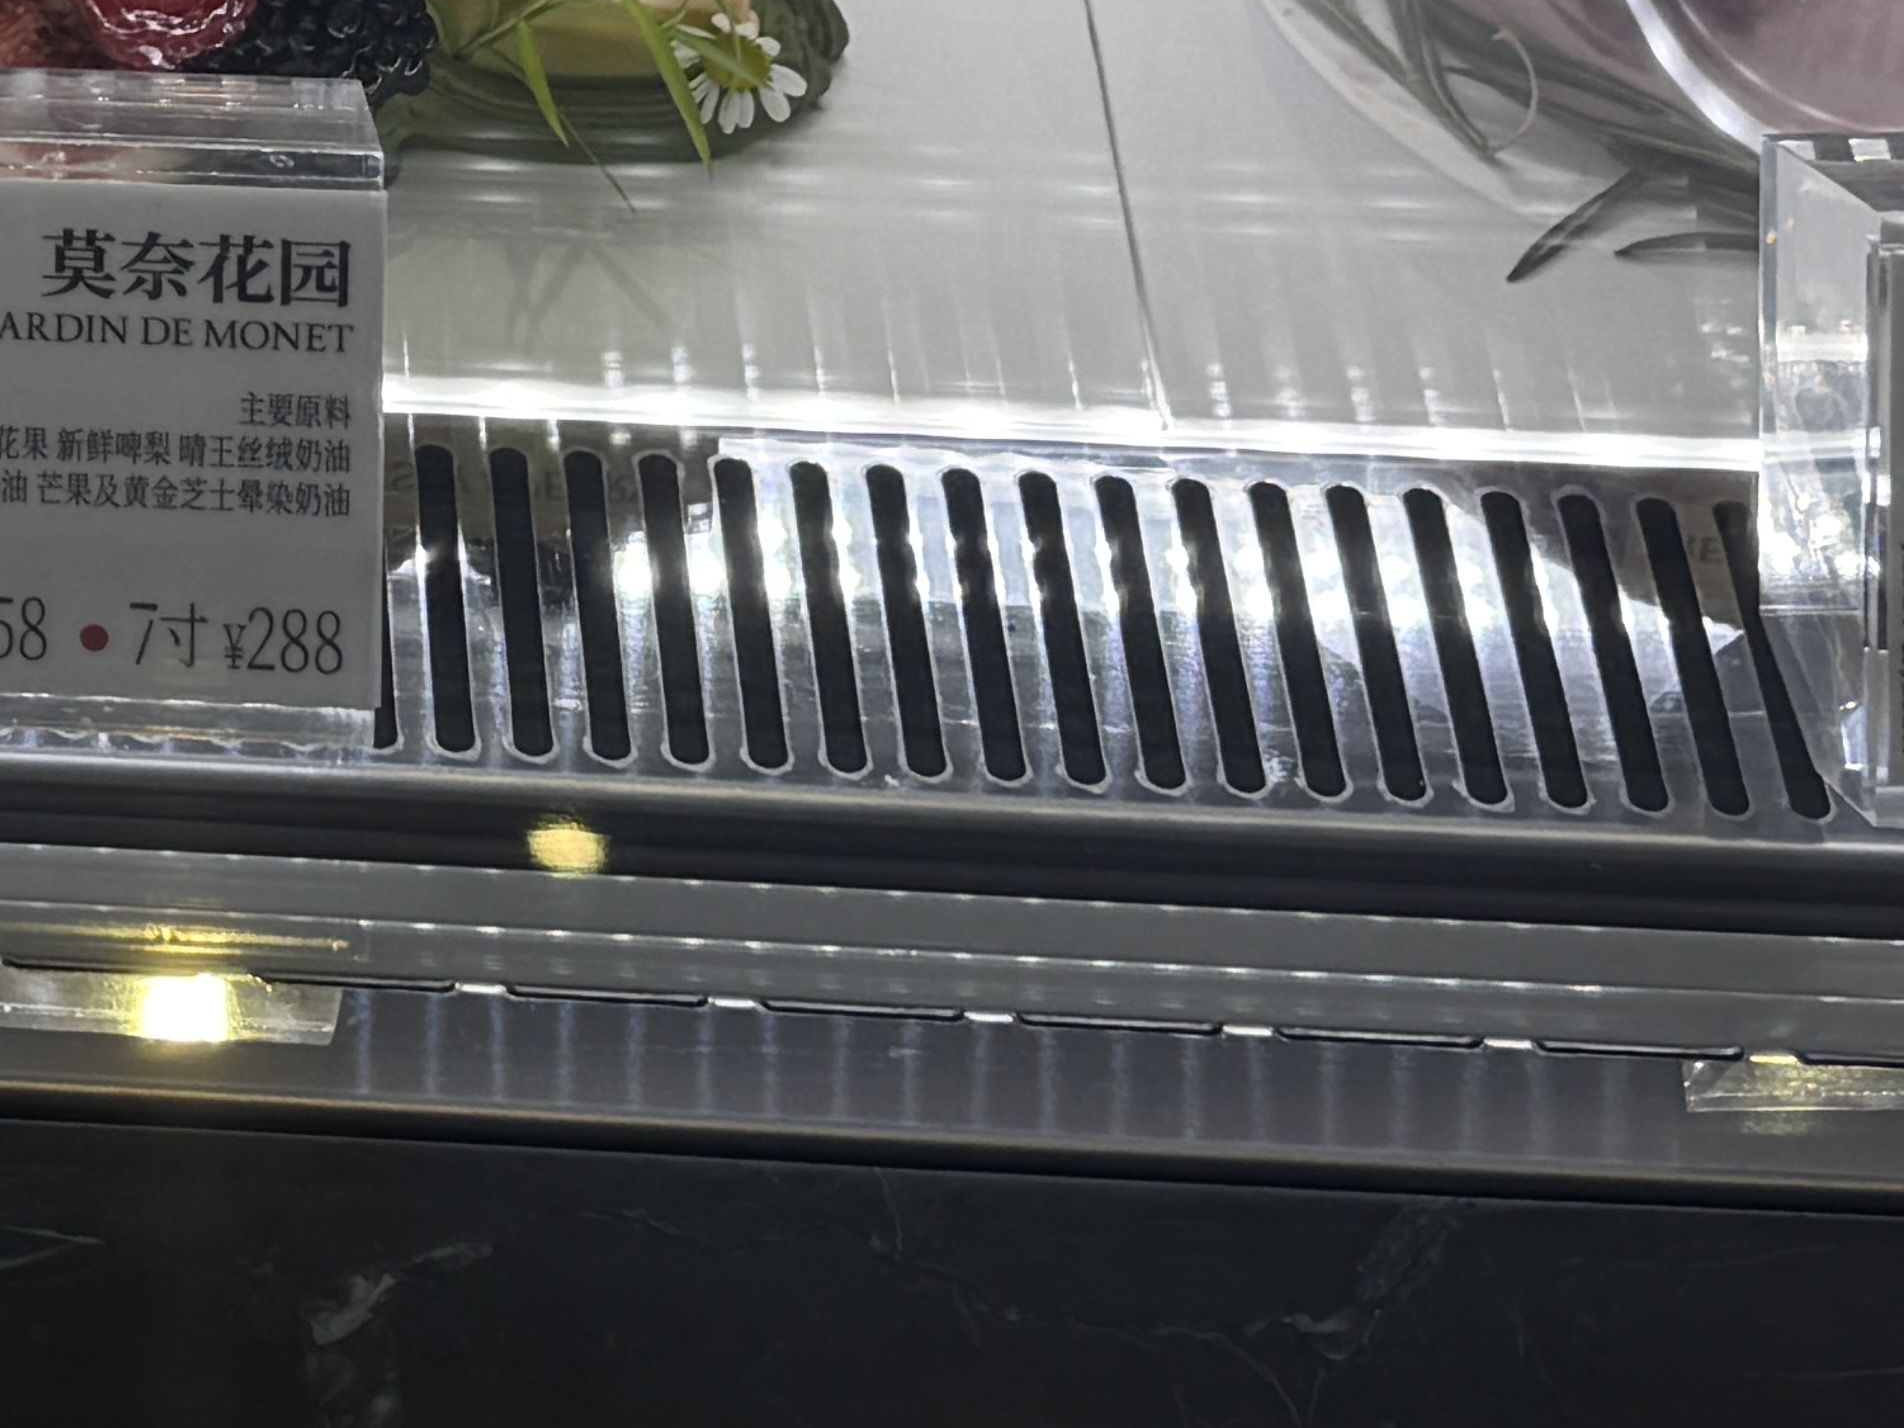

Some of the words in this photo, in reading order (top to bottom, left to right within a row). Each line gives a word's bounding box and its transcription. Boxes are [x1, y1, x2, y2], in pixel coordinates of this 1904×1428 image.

[41, 228, 352, 308] 莫奈花园
[142, 315, 193, 346] DE
[203, 318, 354, 353] MONET
[238, 392, 351, 430] 主要原料
[56, 427, 171, 466] 新鲜啤梨
[178, 432, 351, 473] 晴王丝绒奶油
